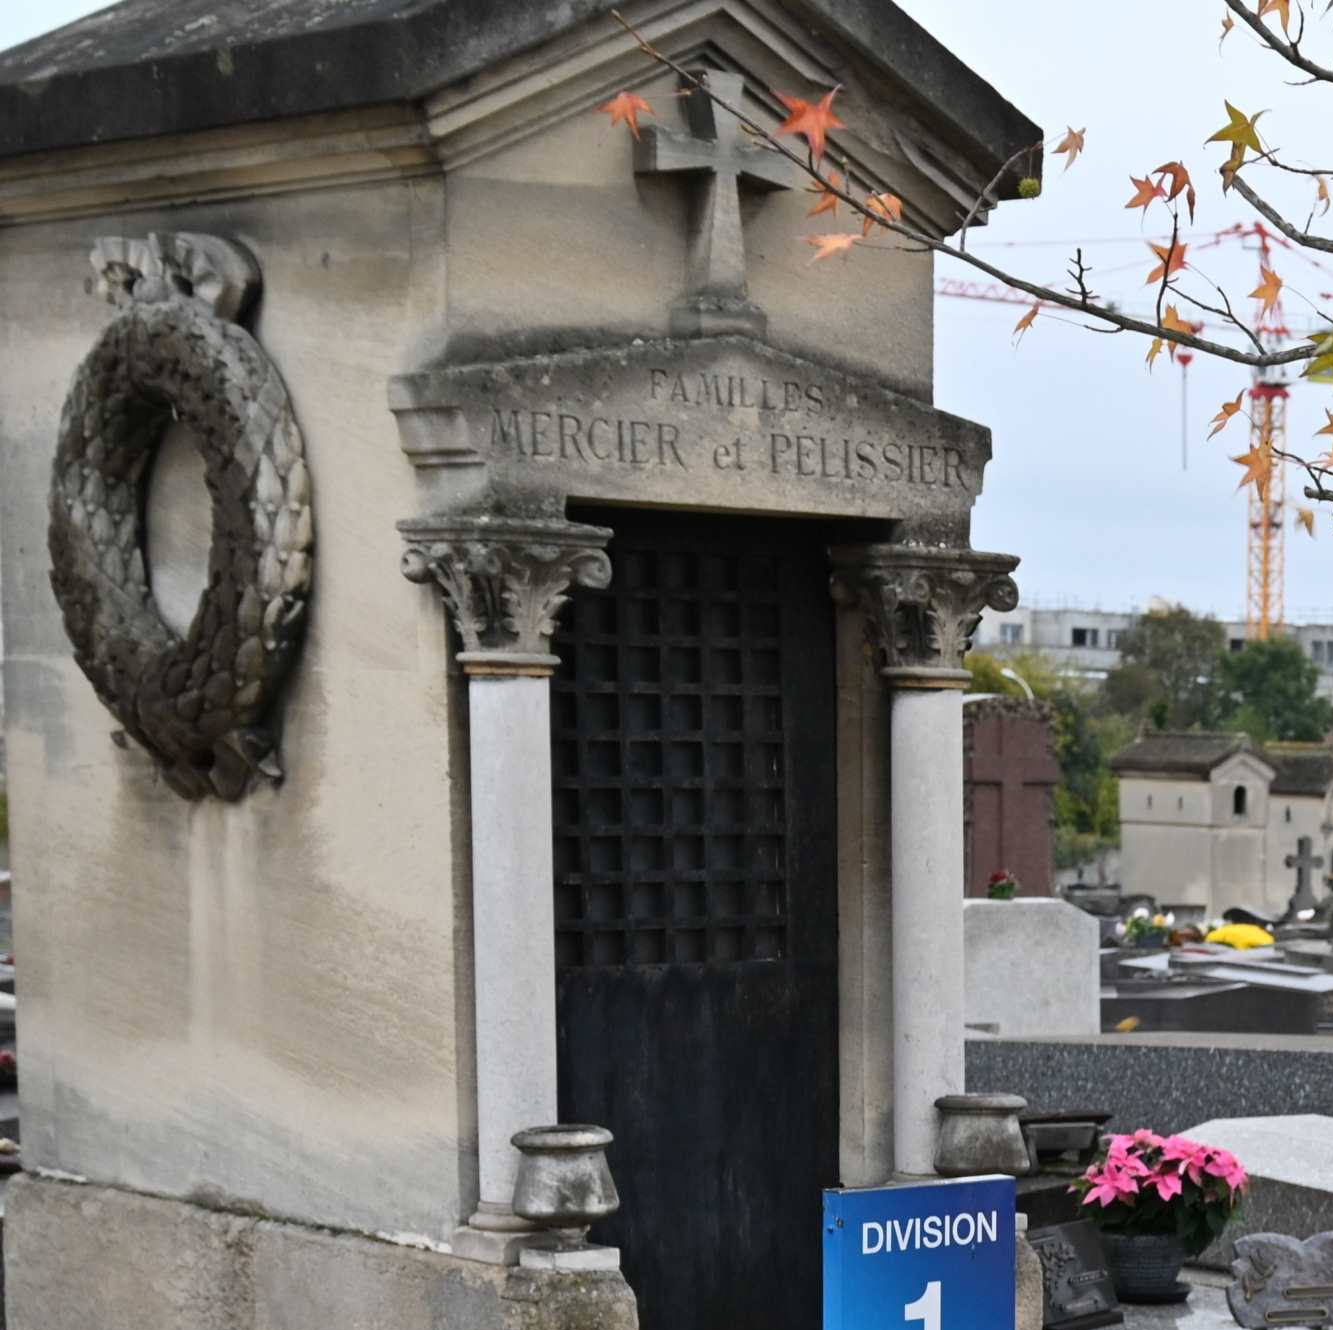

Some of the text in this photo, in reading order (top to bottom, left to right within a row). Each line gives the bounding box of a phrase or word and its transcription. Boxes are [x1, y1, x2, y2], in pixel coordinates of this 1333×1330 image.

[648, 367, 825, 415] FAMILLES
[490, 408, 690, 472] MERCIER
[712, 435, 748, 471] et
[861, 1210, 998, 1255] DIVISION
